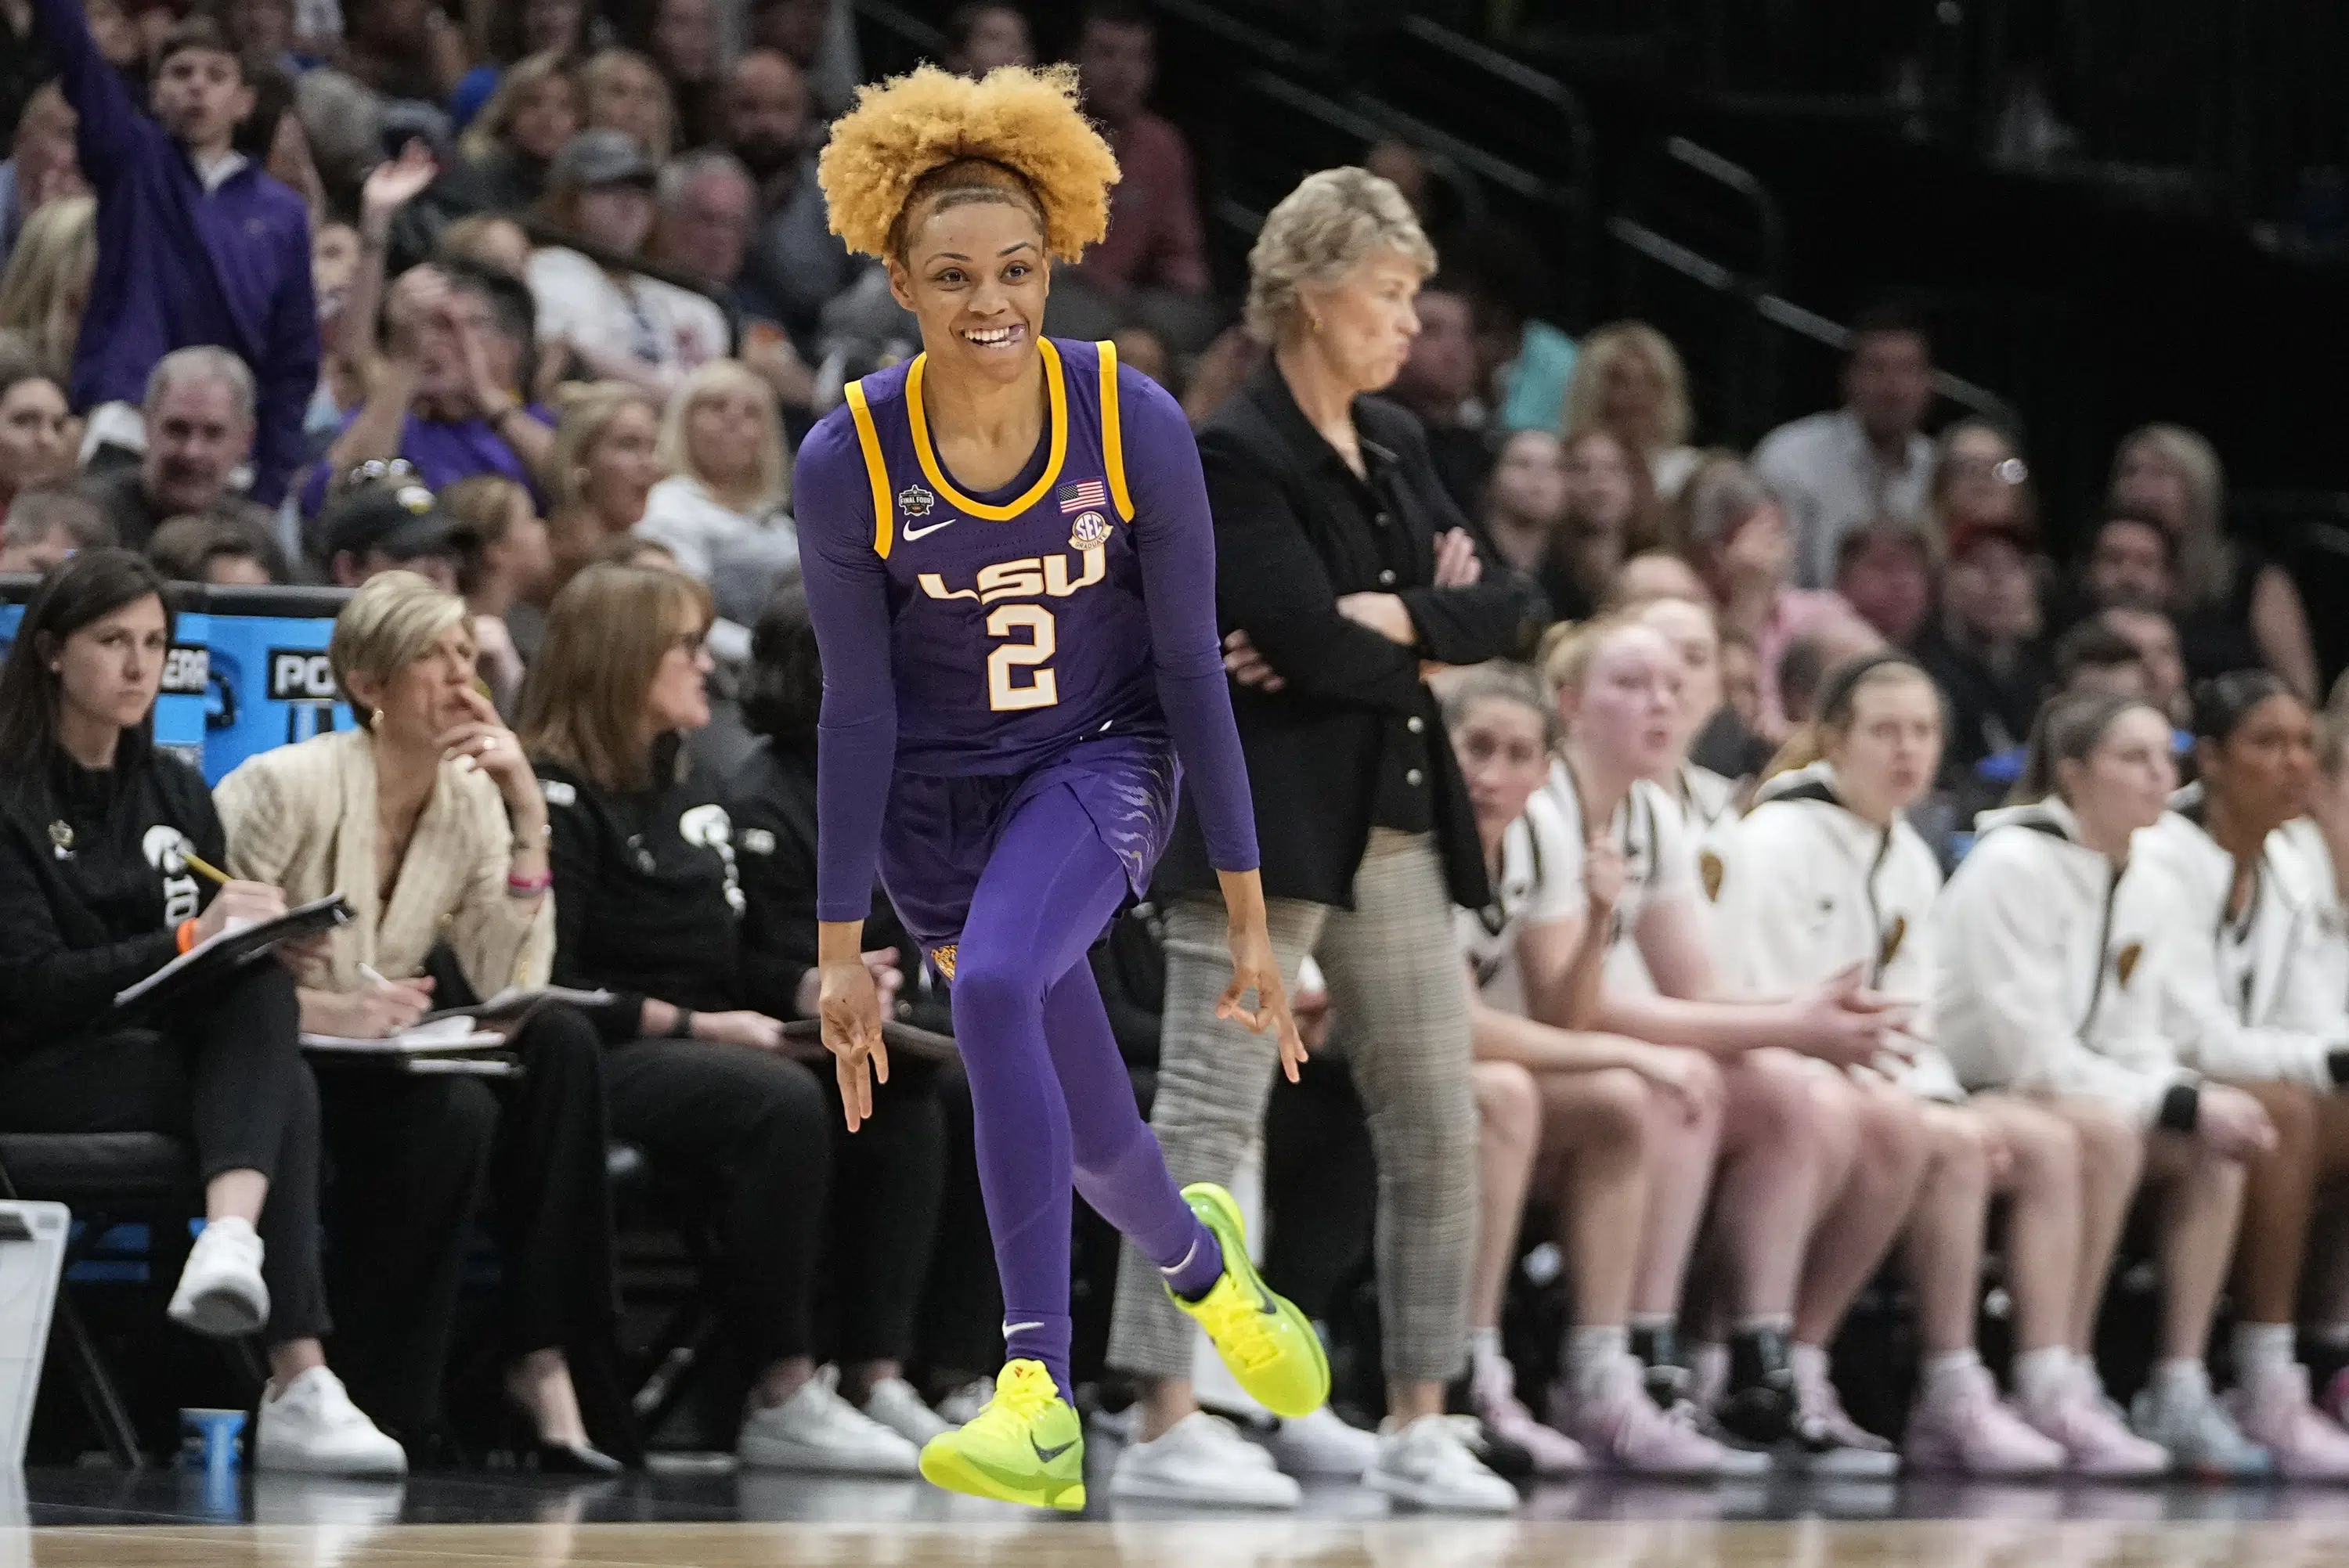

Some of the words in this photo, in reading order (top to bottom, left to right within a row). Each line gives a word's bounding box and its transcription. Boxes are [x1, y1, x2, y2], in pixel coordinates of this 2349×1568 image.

[900, 496, 916, 505] FINAL
[1075, 514, 1102, 541] SEC
[1074, 535, 1106, 549] GRADUATE
[918, 543, 1106, 605] LSU
[986, 604, 1059, 711] 2
